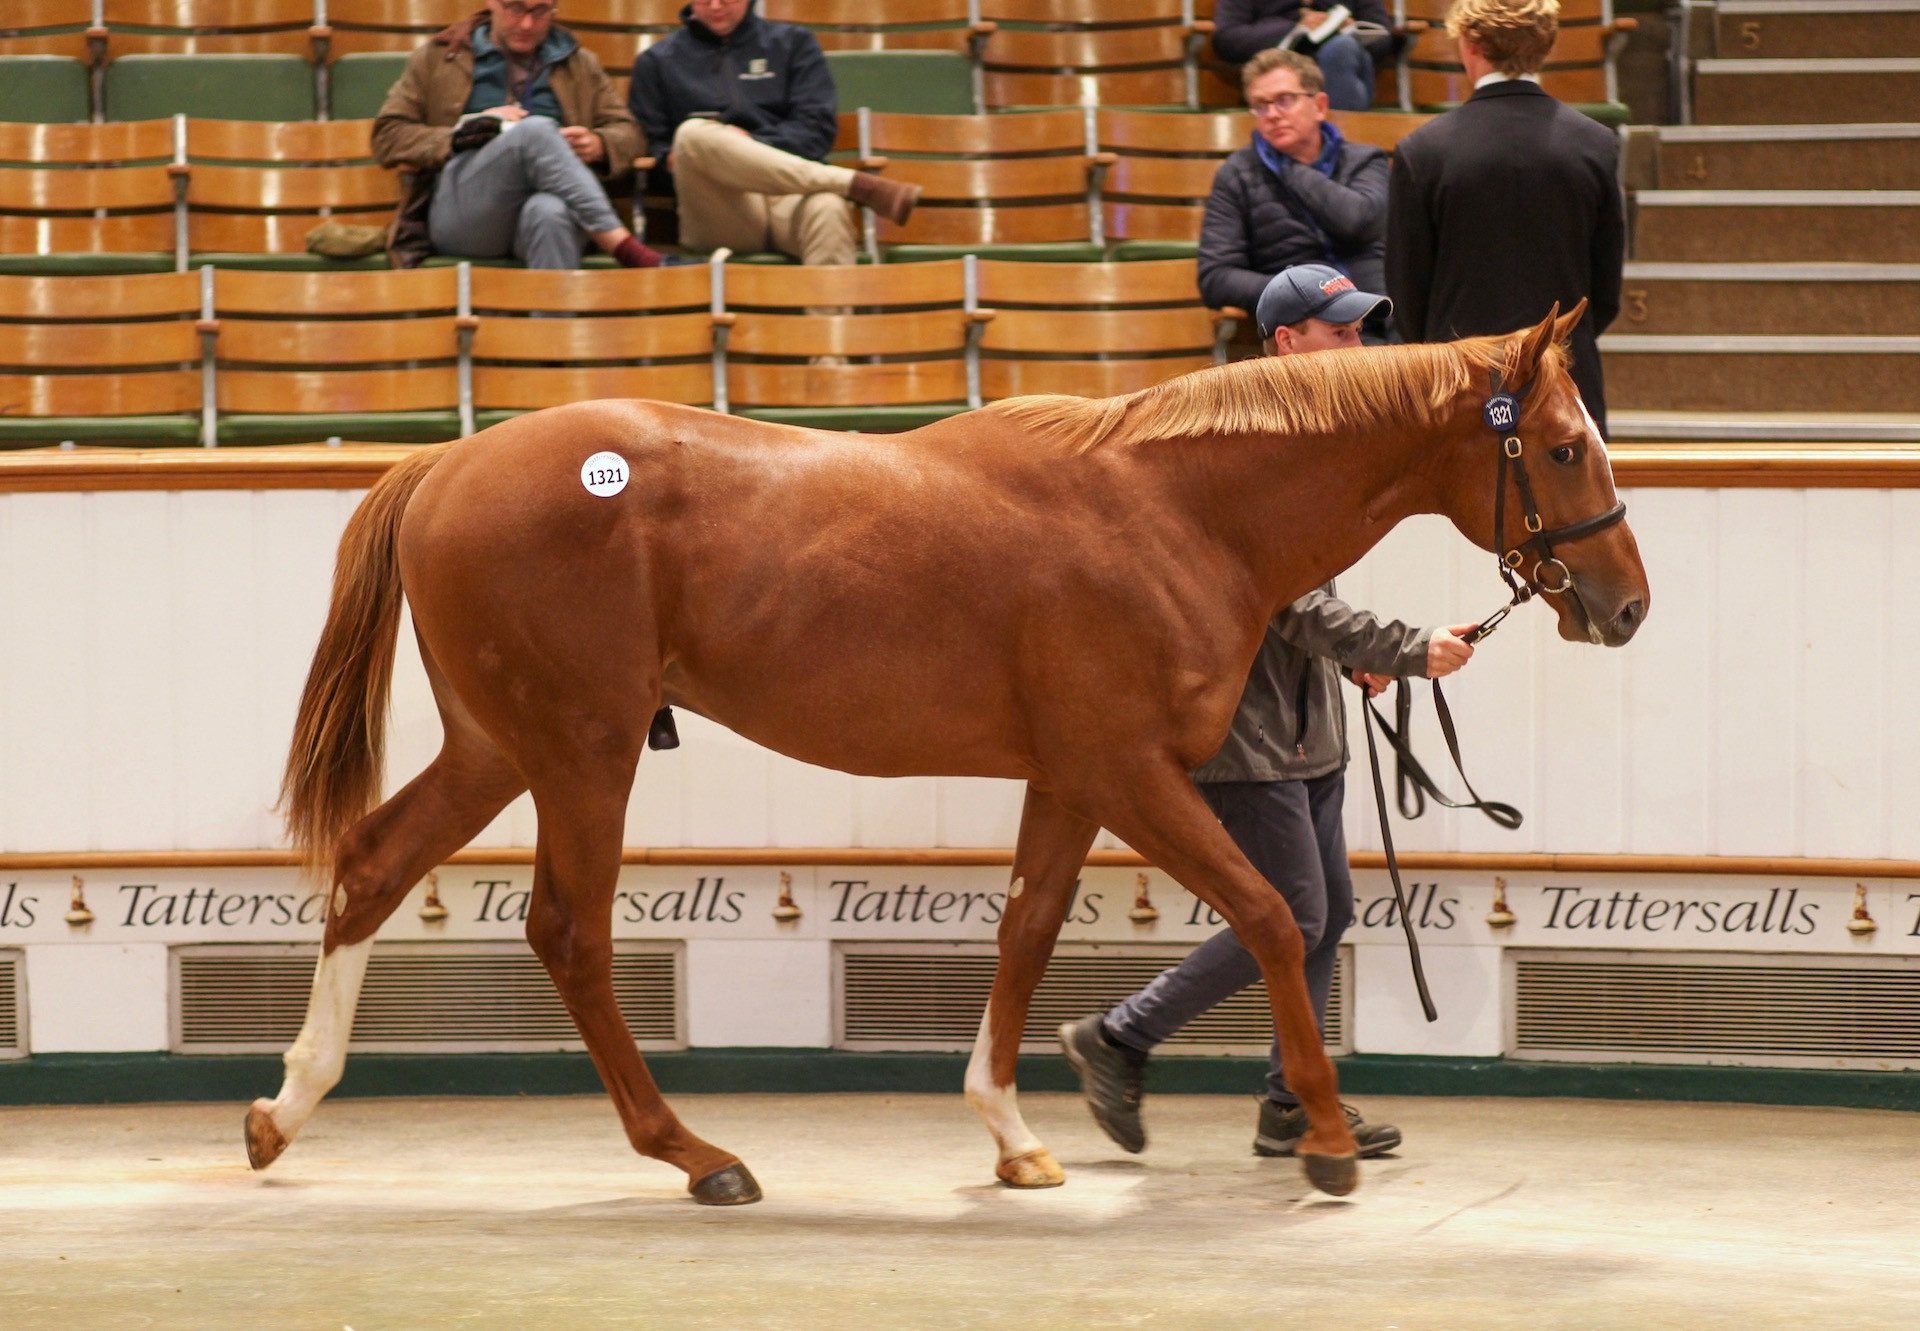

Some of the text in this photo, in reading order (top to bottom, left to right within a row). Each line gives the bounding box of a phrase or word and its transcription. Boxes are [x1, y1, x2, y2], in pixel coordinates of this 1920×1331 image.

[1742, 21, 1760, 49] 5
[1628, 290, 1649, 321] 3
[1489, 405, 1513, 425] 1321
[588, 468, 624, 486] 1321
[118, 884, 329, 927] Tattersa
[473, 877, 746, 923] Tasalls
[830, 879, 1103, 924] Tattersls
[1541, 886, 1820, 935] Tattersalls
